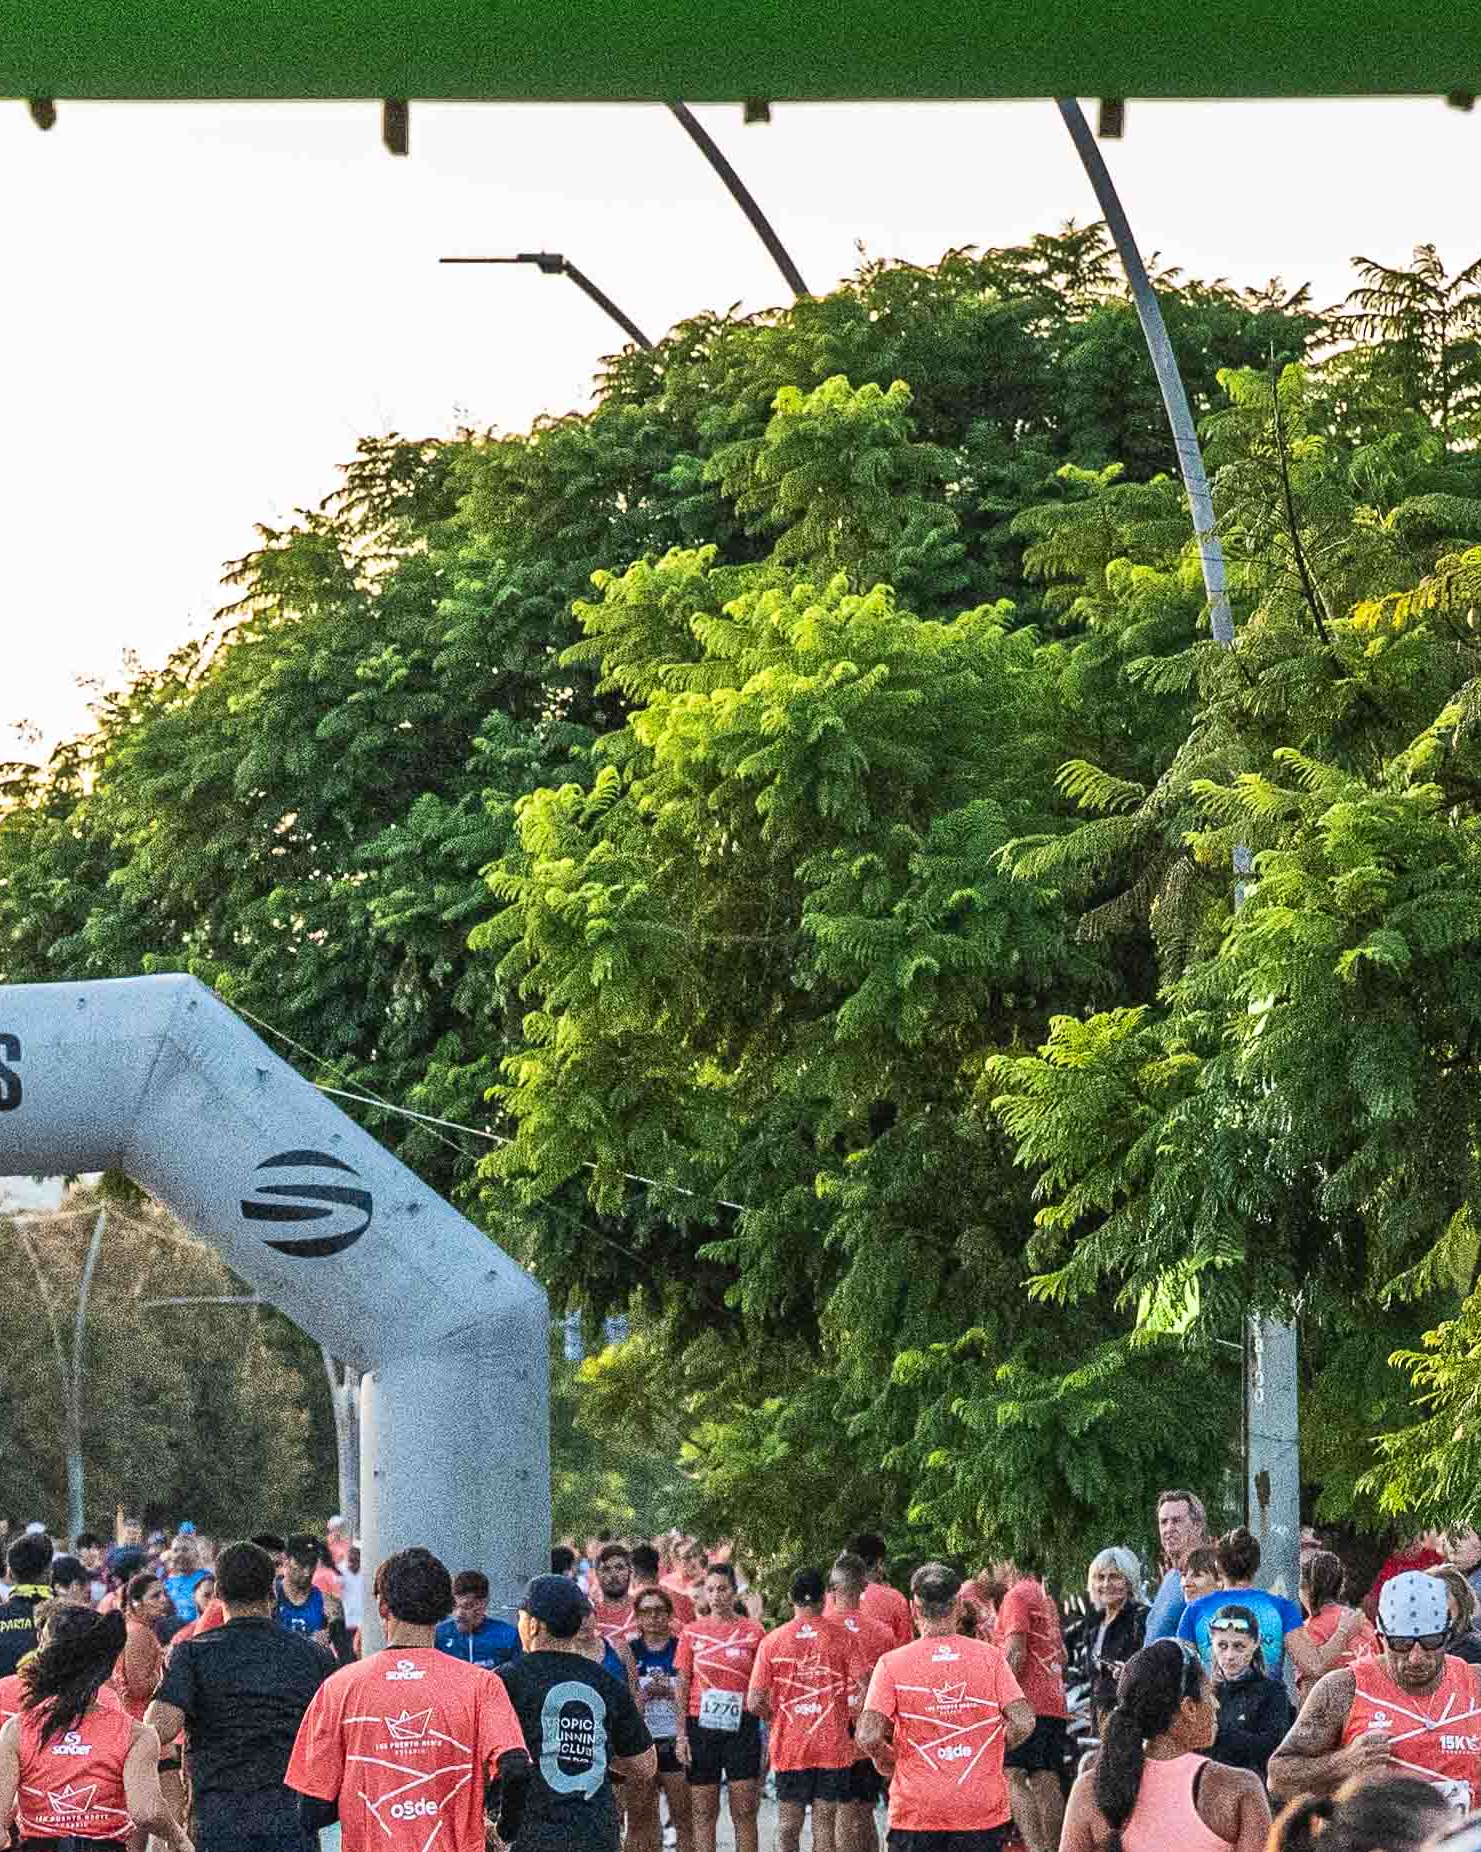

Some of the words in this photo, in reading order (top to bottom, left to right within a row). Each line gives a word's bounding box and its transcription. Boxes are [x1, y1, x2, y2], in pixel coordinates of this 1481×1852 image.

[702, 1702, 740, 1716] 1770
[1440, 1735, 1465, 1750] 15K
[390, 1797, 439, 1820] osde
